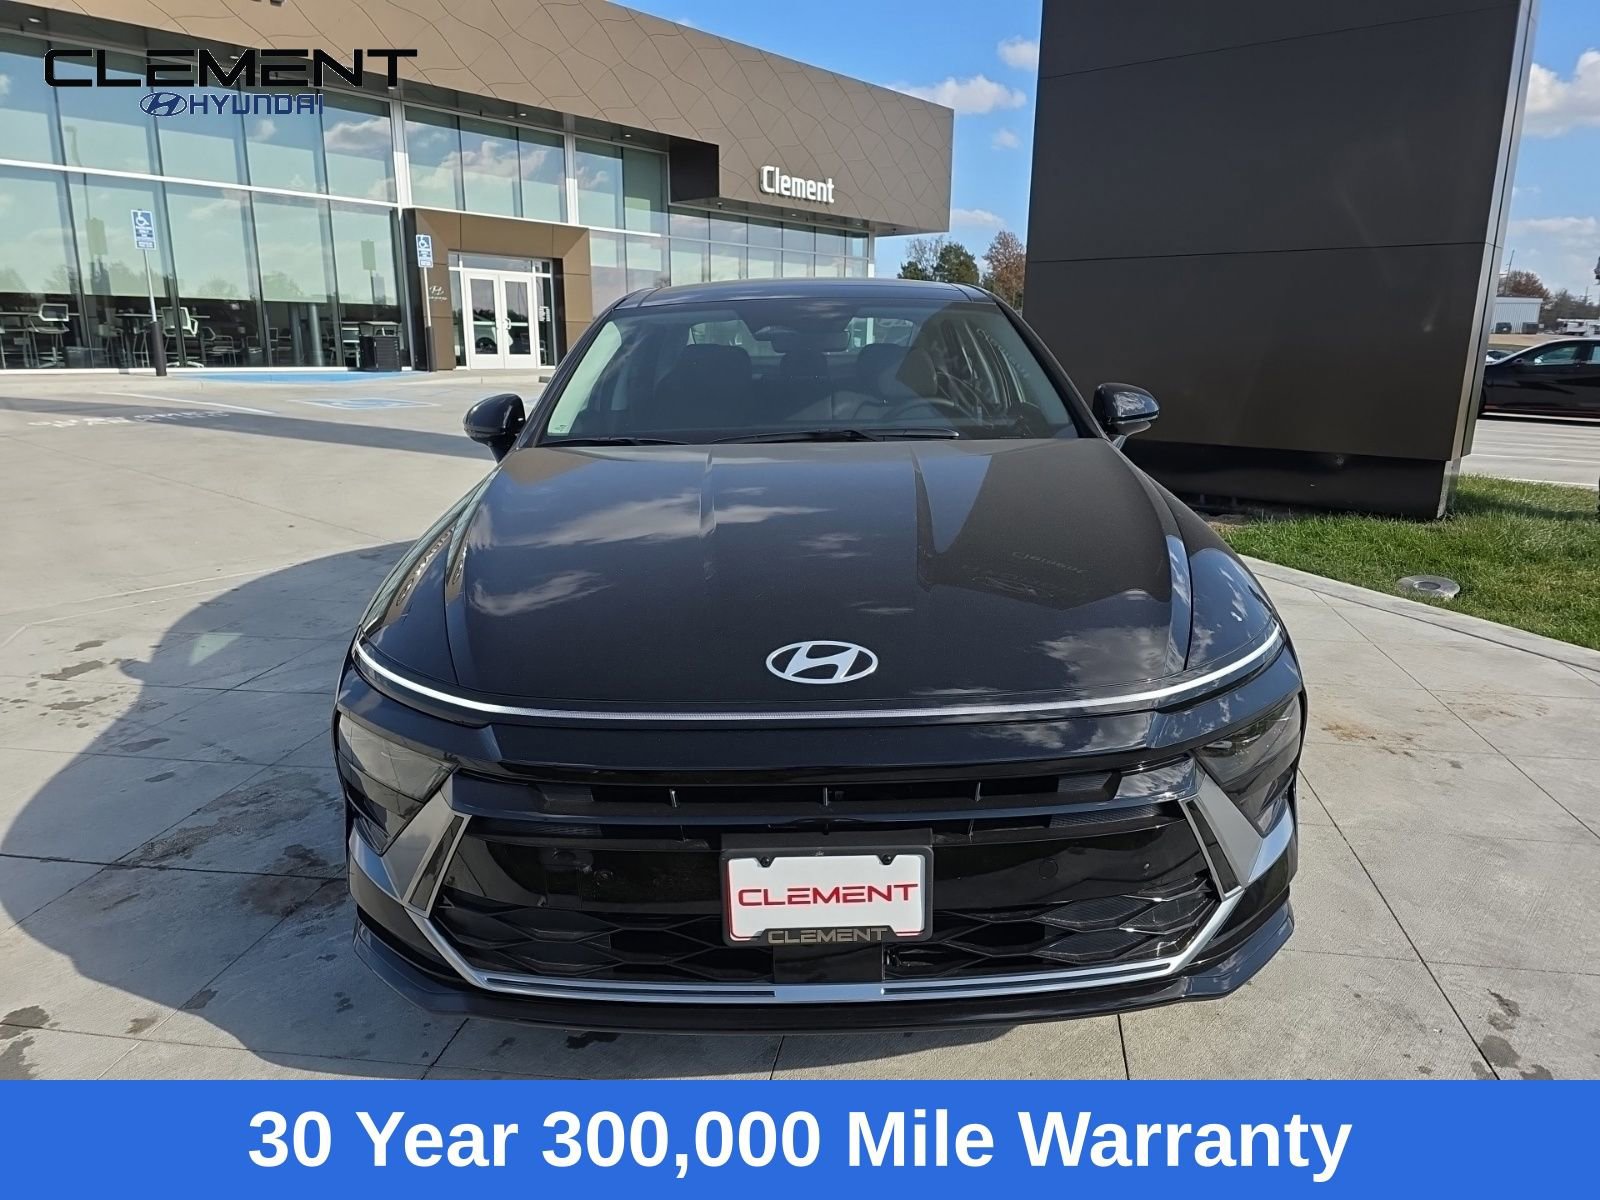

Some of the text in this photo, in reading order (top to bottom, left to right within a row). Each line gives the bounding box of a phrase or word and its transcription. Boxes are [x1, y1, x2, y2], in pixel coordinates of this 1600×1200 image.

[760, 165, 835, 203] Clement
[738, 884, 918, 906] CLEMENT
[767, 927, 888, 944] CLEMENT
